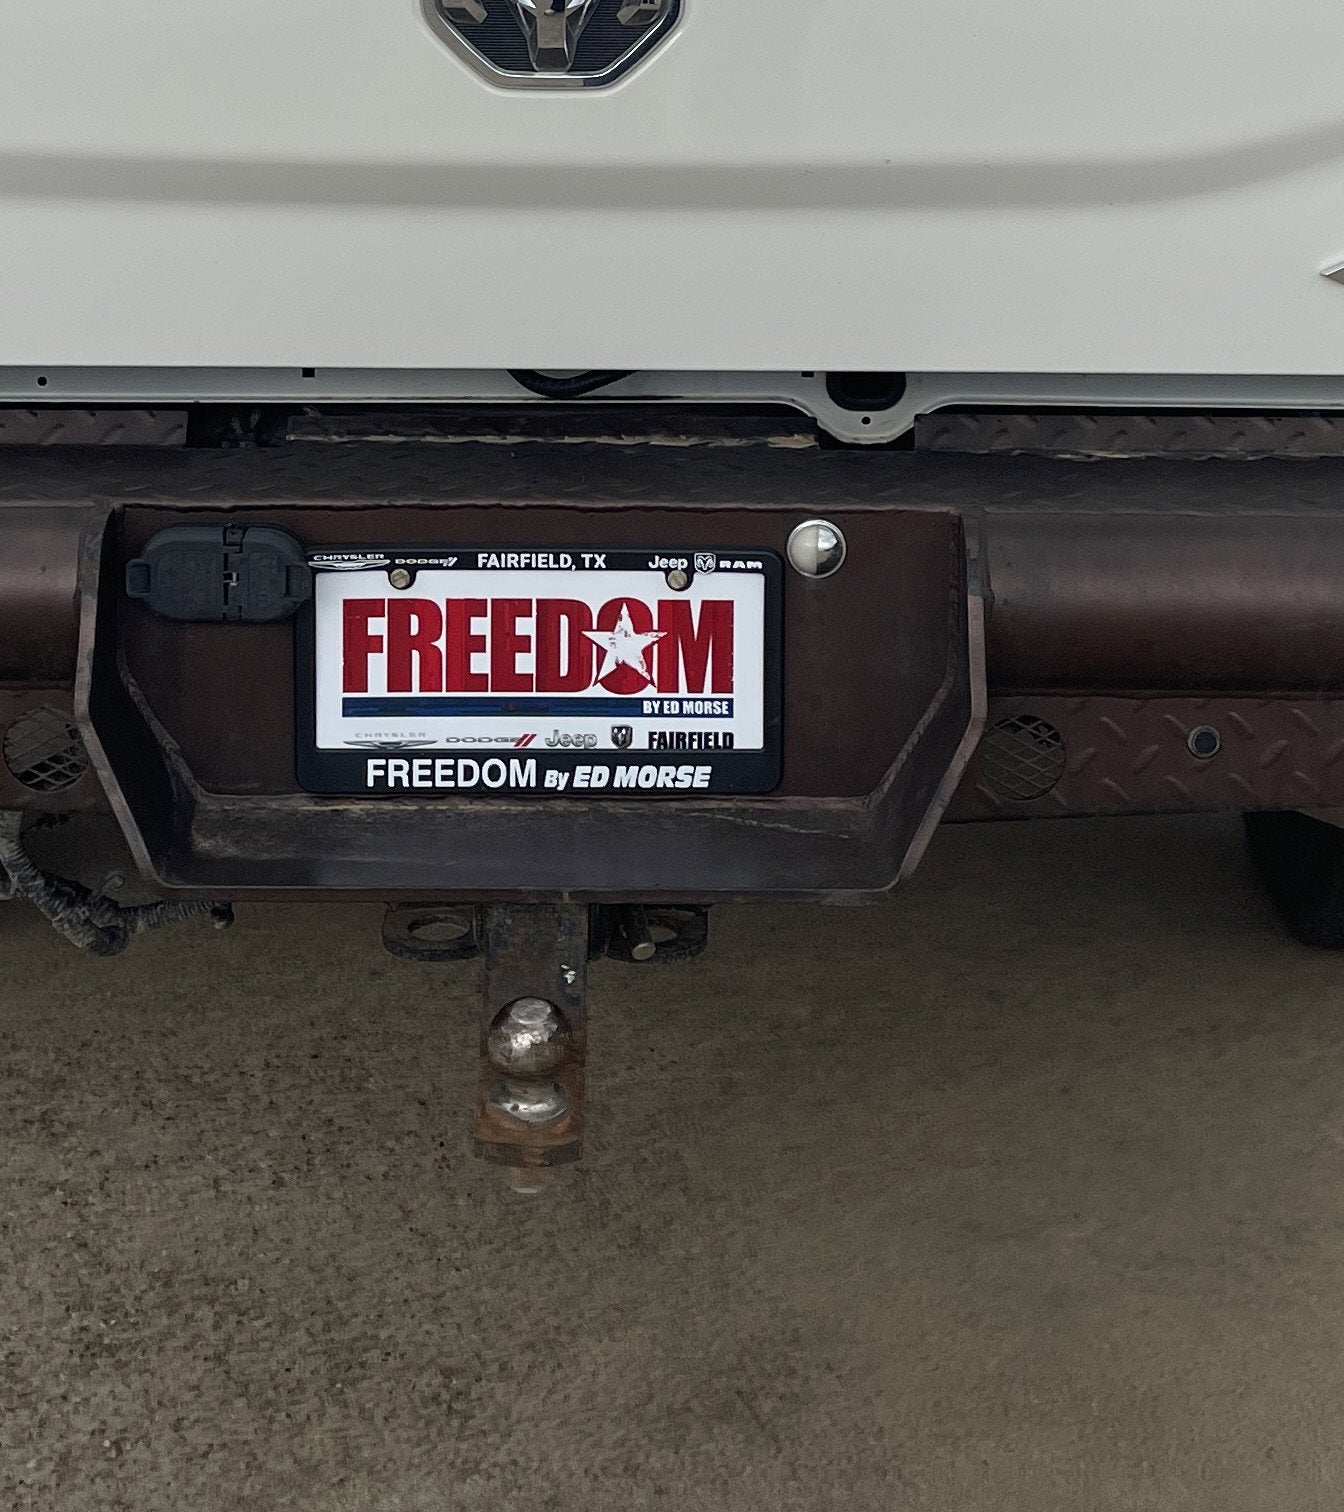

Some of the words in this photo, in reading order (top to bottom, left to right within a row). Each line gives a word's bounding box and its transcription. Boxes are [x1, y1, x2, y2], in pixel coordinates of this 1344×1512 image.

[313, 553, 385, 561] CHRYSLER
[477, 553, 576, 571] FAIRFIELD,
[580, 553, 607, 569] TX
[648, 555, 689, 570] Jeep
[719, 560, 763, 569] RAM
[342, 597, 735, 695] FREEDOM
[642, 700, 661, 714] BY
[663, 700, 680, 714] ED
[682, 700, 729, 715] MORSE
[545, 729, 598, 749] Jeep
[648, 731, 735, 749] FAIRFIELD
[366, 758, 537, 788] FREEDOM
[572, 765, 610, 788] ED
[612, 765, 712, 788] MORSE
